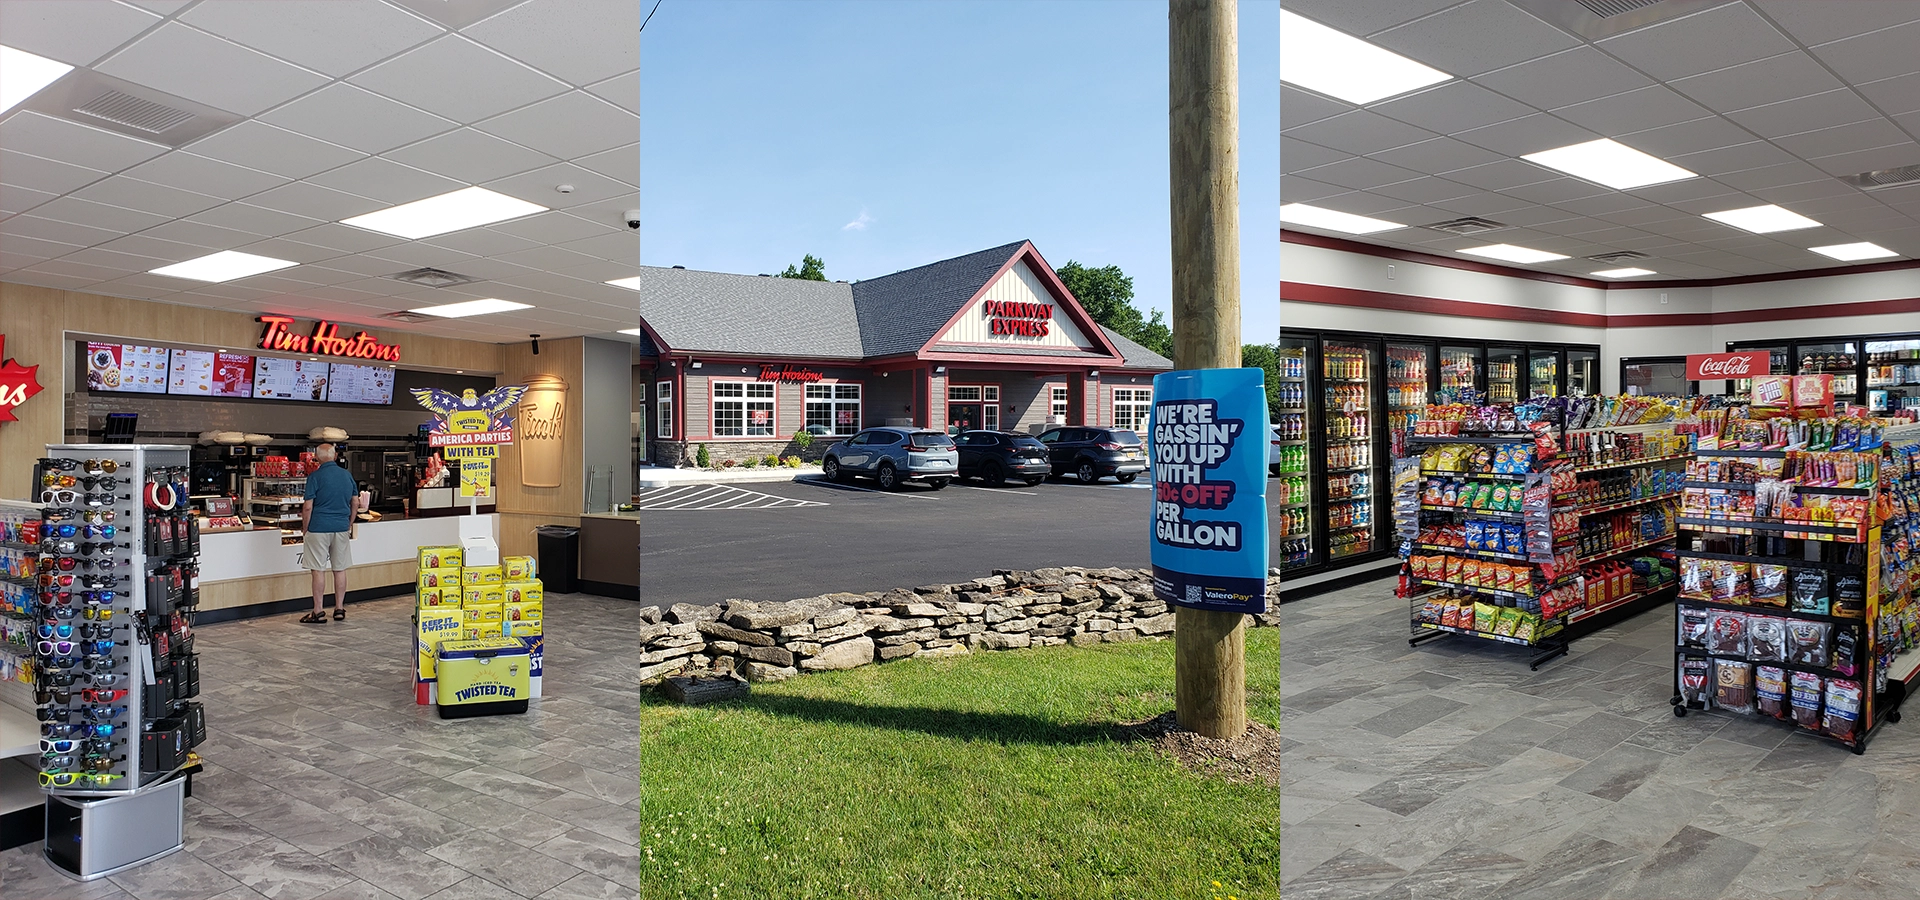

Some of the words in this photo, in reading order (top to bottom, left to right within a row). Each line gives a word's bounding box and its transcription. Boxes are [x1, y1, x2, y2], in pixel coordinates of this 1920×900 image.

[986, 300, 1054, 319] PARKWAY
[992, 318, 1049, 337] EXPRESS
[260, 316, 310, 353] Tim
[312, 320, 401, 362] Hortons
[759, 364, 780, 380] Tim
[782, 364, 823, 381] Hortons
[1699, 355, 1753, 376] Coca-Cola
[1758, 381, 1780, 394] slim
[1763, 390, 1782, 403] jim
[1156, 404, 1212, 424] WE'RE
[432, 434, 472, 445] AMERICA
[474, 432, 511, 442] PARTIES
[1155, 424, 1238, 444] GASSIN'
[448, 447, 474, 457] WITH
[476, 447, 495, 456] TEA
[1155, 444, 1186, 463] YOU
[1190, 445, 1225, 464] UP
[1156, 464, 1200, 484] WITH
[1157, 482, 1179, 502] 50¢
[1181, 484, 1230, 505] OFF
[1157, 501, 1180, 522] PER
[1156, 521, 1236, 547] GALLON
[422, 619, 443, 627] KEEP
[422, 622, 459, 633] TWISTED
[455, 685, 497, 702] TWISTED
[499, 685, 516, 698] TEA
